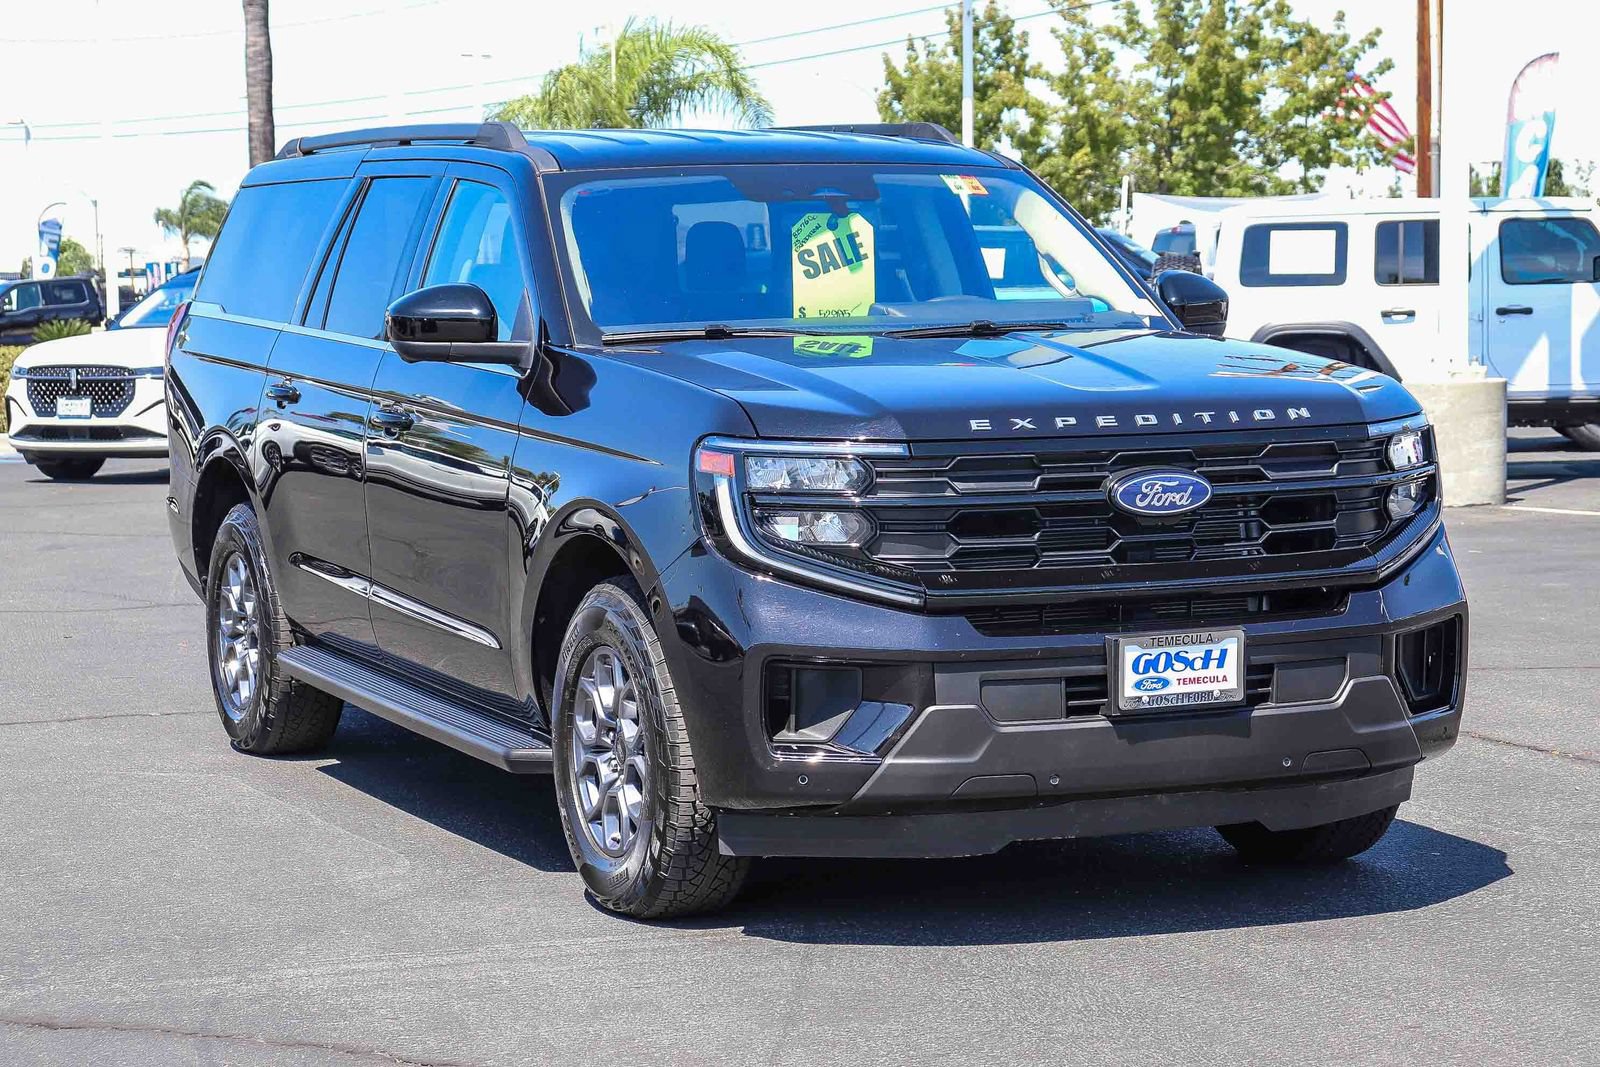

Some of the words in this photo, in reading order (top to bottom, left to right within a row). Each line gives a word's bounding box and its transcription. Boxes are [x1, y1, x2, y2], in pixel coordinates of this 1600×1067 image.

[797, 231, 869, 280] SALE
[969, 407, 1311, 431] EXPEDITION
[1136, 480, 1192, 508] Ford
[1150, 633, 1214, 647] TEMECULA
[1140, 679, 1164, 690] Ford
[1176, 674, 1228, 686] TEMECULA
